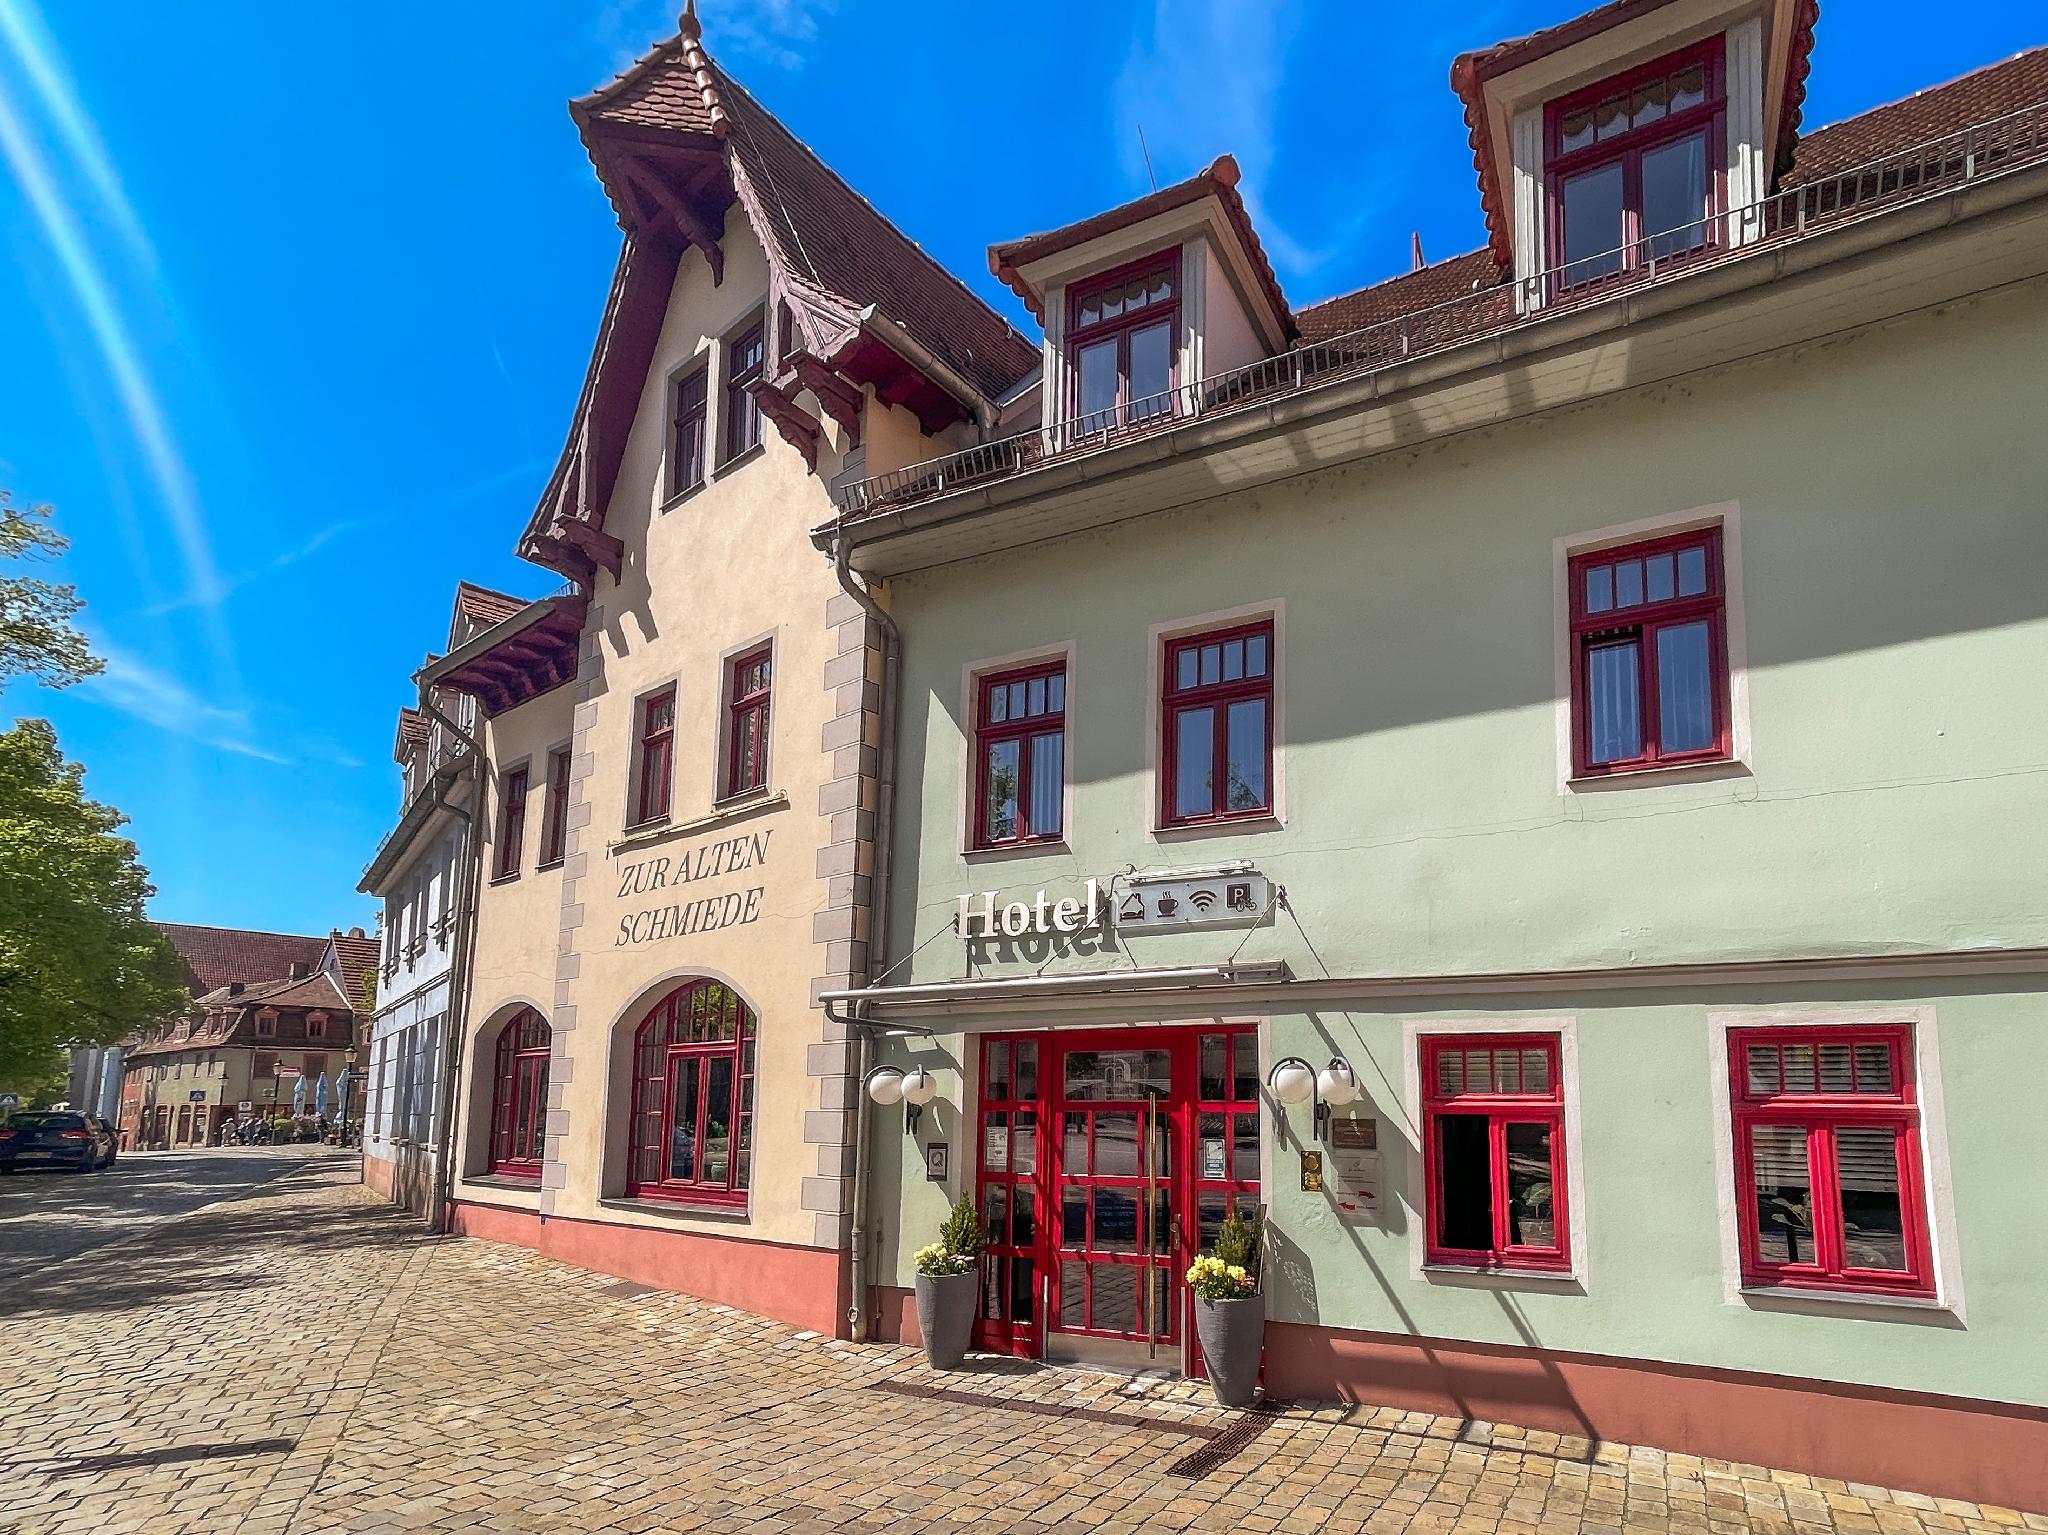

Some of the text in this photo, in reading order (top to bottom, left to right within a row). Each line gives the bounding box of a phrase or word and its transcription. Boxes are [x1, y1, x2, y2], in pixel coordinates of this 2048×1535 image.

[617, 829, 774, 898] ZUR ALTEN
[615, 887, 765, 946] SCHMIEDE
[955, 878, 1100, 939] Hotel
[1234, 888, 1244, 904] P
